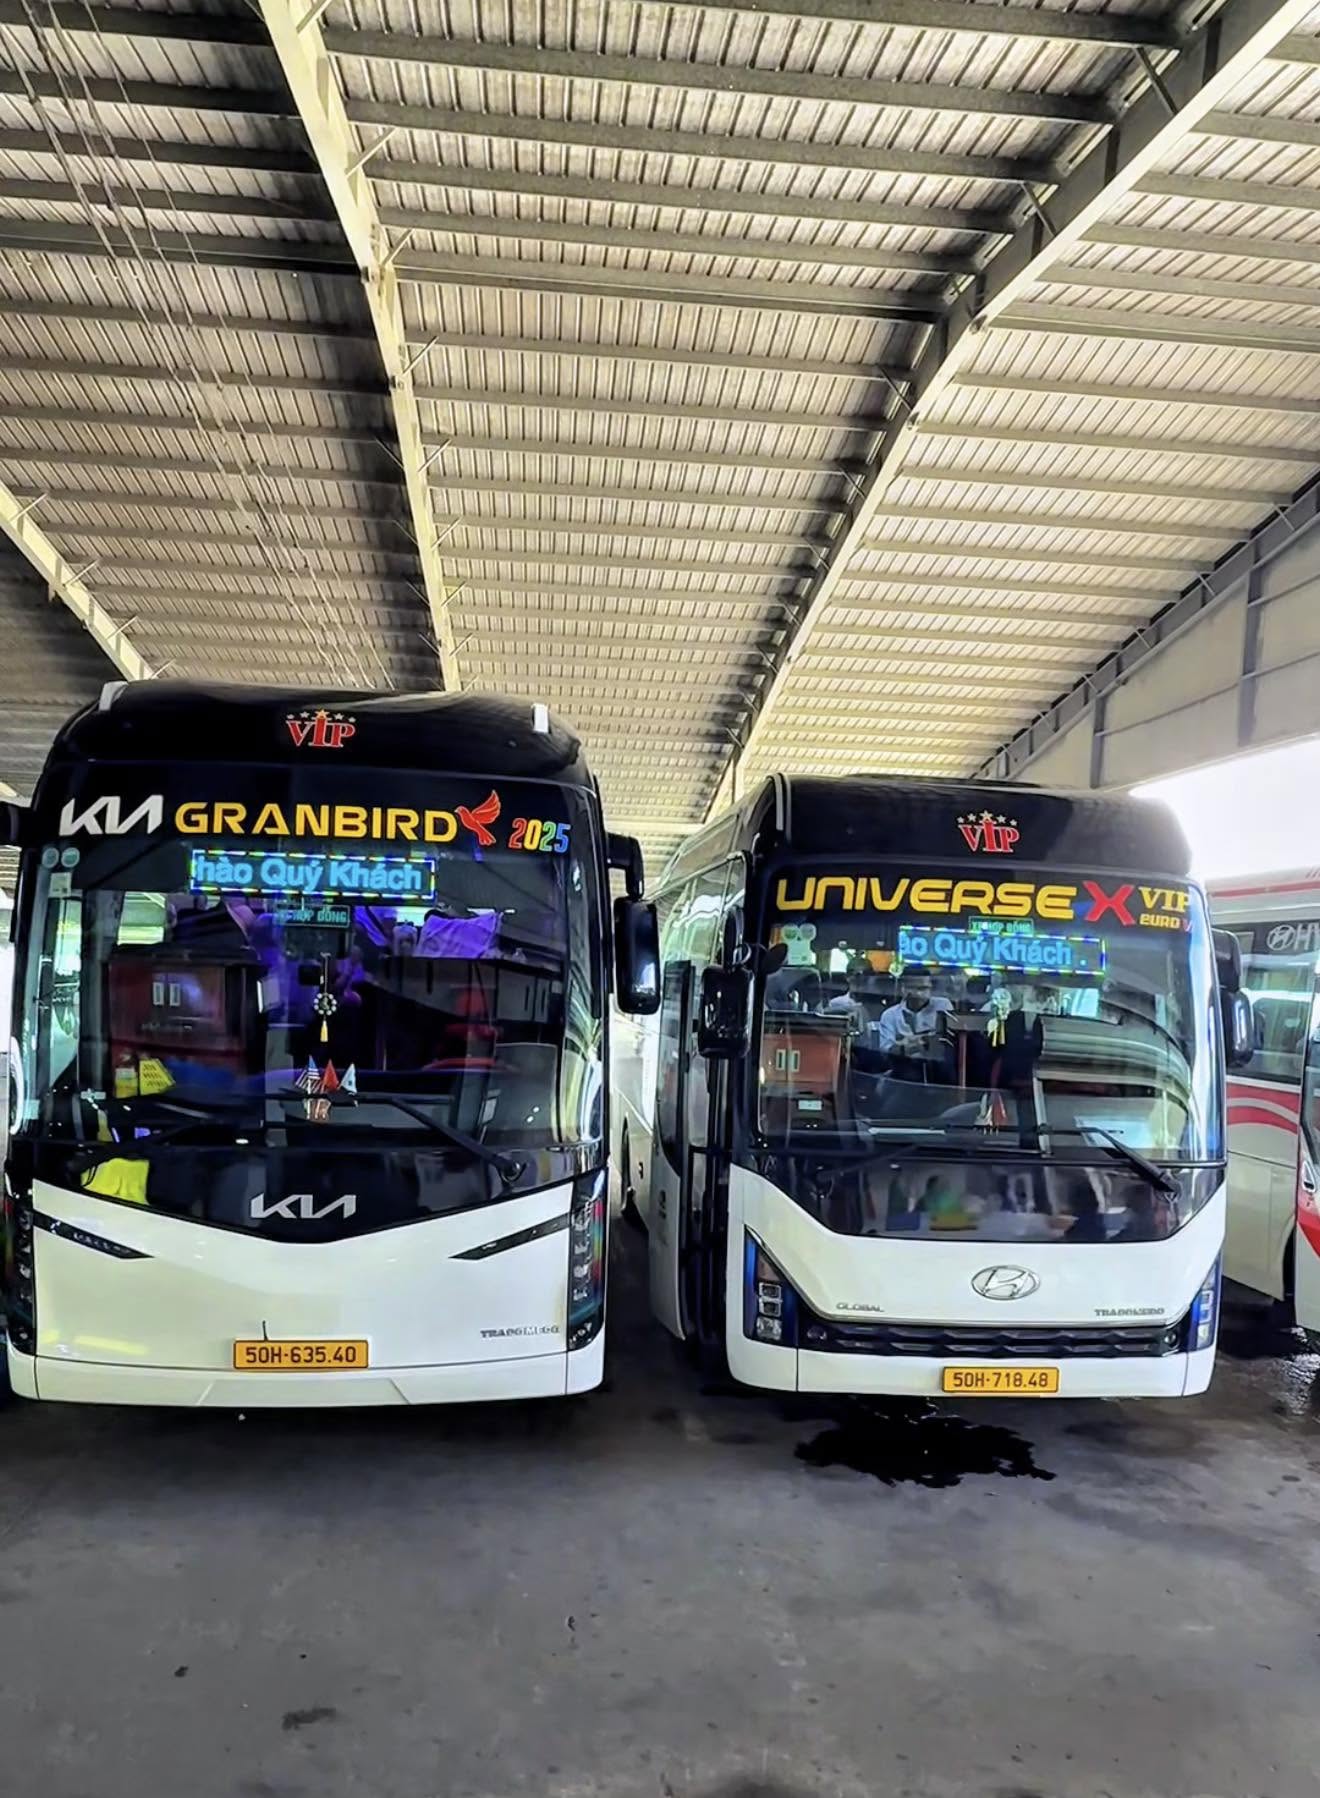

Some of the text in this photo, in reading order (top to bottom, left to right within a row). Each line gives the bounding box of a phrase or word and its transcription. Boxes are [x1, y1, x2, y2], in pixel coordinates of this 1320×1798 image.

[286, 716, 356, 748] VIP
[60, 796, 571, 853] KIA GRANBIRD 2025
[958, 820, 1020, 853] VIP
[260, 858, 323, 893] Quý
[330, 862, 422, 890] Khách
[776, 877, 1190, 926] UNIVERSE X VIP
[934, 933, 987, 966] Quý
[993, 937, 1071, 965] Khách
[249, 1194, 356, 1218] KIA
[245, 1346, 357, 1364] 50H-635.40
[953, 1371, 1049, 1389] 50H-718.48
